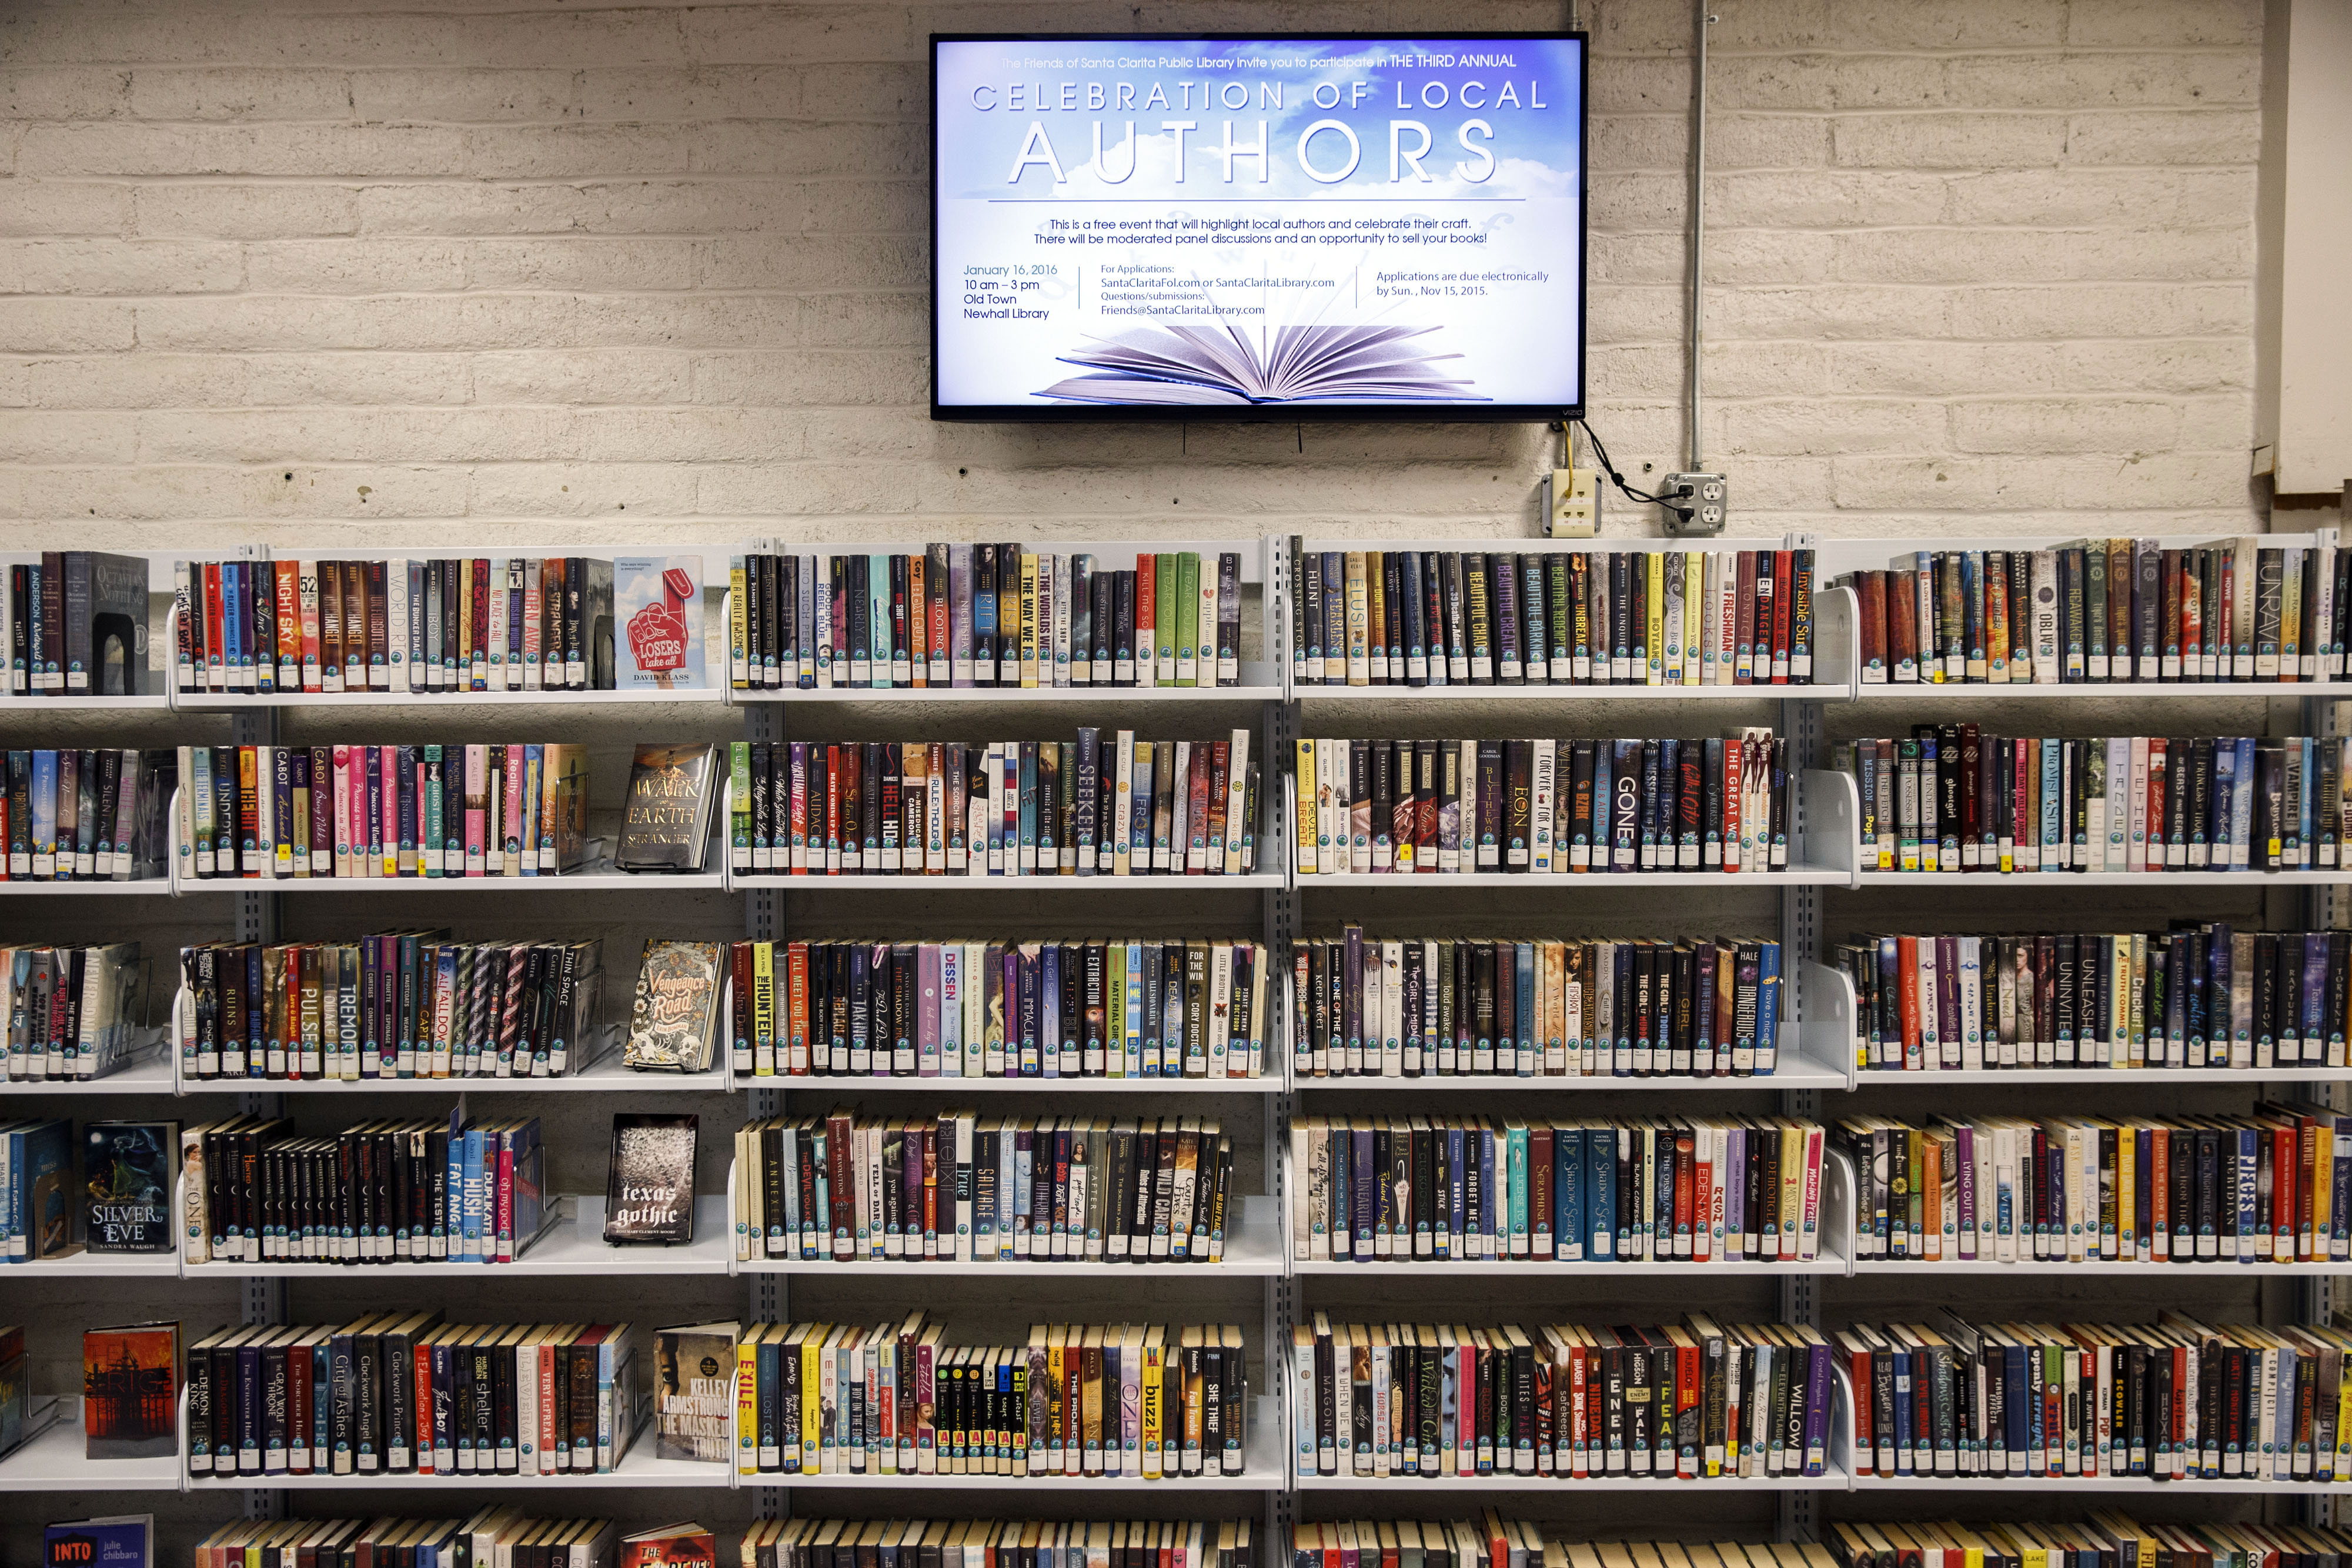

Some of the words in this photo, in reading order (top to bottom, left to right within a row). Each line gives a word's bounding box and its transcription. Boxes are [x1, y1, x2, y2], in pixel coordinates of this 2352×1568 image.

[1002, 58, 1020, 68] The
[1024, 58, 1063, 68] Friends
[1067, 58, 1079, 68] of
[1081, 58, 1114, 68] Santa
[1118, 58, 1155, 68] Clarita
[1159, 58, 1193, 68] Public
[1197, 58, 1234, 70] Library
[1271, 57, 1291, 69] you
[1295, 57, 1307, 68] to
[1310, 56, 1374, 69] participate
[1377, 56, 1387, 67] in
[1390, 55, 1412, 67] THE
[1416, 55, 1454, 67] THIRD
[1458, 55, 1516, 67] ANNUAL
[971, 81, 1283, 111] CELEBRATION
[1313, 81, 1367, 109] OF
[1396, 81, 1547, 109] LOCAL
[1007, 121, 1496, 183] AUTHORS
[1051, 219, 1070, 229] This
[1073, 219, 1079, 229] is
[1094, 219, 1115, 229] free
[1120, 220, 1152, 229] event
[1155, 219, 1178, 229] that
[1182, 219, 1198, 229] will
[1201, 219, 1249, 232] highlight
[1252, 219, 1280, 229] local
[1284, 219, 1325, 229] authors
[1328, 219, 1351, 229] and
[1355, 219, 1410, 229] celebrate
[1414, 219, 1438, 229] their
[1442, 219, 1471, 229] craft.
[1035, 234, 1065, 244] There
[1068, 234, 1085, 244] will
[1088, 234, 1104, 244] be
[1107, 234, 1172, 244] moderated
[1176, 234, 1208, 246] panel
[1211, 233, 1271, 244] discussions
[1275, 233, 1298, 243] and
[1319, 233, 1384, 245] opportunity
[1388, 233, 1399, 243] to
[1402, 233, 1419, 243] sell
[1423, 235, 1446, 245] your
[1451, 233, 1487, 243] books!
[964, 265, 1009, 276] January
[1013, 265, 1029, 276] 16,
[1031, 265, 1057, 275] 2016
[1101, 265, 1115, 273] For
[1118, 265, 1174, 275] Applications:
[1377, 272, 1439, 282] Applications
[1460, 271, 1479, 281] due
[1482, 271, 1548, 282] electronically
[965, 280, 976, 290] 10
[1011, 280, 1017, 290] 3
[1021, 282, 1039, 292] pm
[1216, 278, 1334, 289] SantaClaritaLibrary.com
[1377, 286, 1388, 296] by
[1391, 287, 1412, 295] Sun.
[1421, 287, 1440, 295] Nov
[1444, 287, 1458, 297] 15,
[1462, 287, 1488, 295] 2015.
[964, 295, 984, 305] Old
[987, 295, 1017, 305] Town
[1101, 292, 1204, 302] Questions/submissions:
[964, 309, 1008, 319] Newhall
[1013, 309, 1049, 321] Library
[1101, 305, 1264, 316] Friends@SantaClaritaLibrary.com
[279, 573, 292, 616] NIGHT
[913, 584, 924, 620] BOX
[1308, 571, 1317, 609] HUNT
[1797, 571, 1811, 621] Invisible
[980, 593, 992, 635] RIFT
[1722, 593, 1733, 651] FRESHMAN
[15, 621, 24, 646] TWISTED
[279, 619, 293, 644] SKY
[913, 623, 924, 647] OUT
[640, 640, 681, 658] LOSERS
[646, 657, 664, 667] take
[666, 656, 677, 666] all
[315, 750, 325, 784] CABOT
[1729, 748, 1738, 770] THE
[636, 777, 698, 797] WALK
[1865, 760, 1873, 801] MISSION
[1078, 765, 1094, 840] SEEKER
[1617, 776, 1636, 839] GONE
[627, 808, 695, 824] EARTH
[945, 954, 956, 1000] DESSEN
[1189, 972, 1203, 980] WIN
[1190, 962, 1202, 970] THE
[648, 968, 704, 995] Vengeance
[1087, 957, 1099, 1005] EXTRACTION
[654, 989, 691, 1019] Road
[1736, 986, 1756, 1038] DANGEROUS
[2132, 977, 2144, 1027] Cracker!
[300, 989, 318, 1041] PULSE
[623, 1184, 676, 1202] texas
[957, 1169, 971, 1196] true
[978, 1169, 994, 1218] SALVAGE
[464, 1178, 482, 1217] HUSH
[1713, 1187, 1723, 1222] RASH
[92, 1205, 163, 1225] SILVER
[617, 1205, 677, 1228] gothic
[103, 1224, 144, 1242] EVE
[360, 1356, 370, 1409] Clockwork
[739, 1360, 755, 1409] EXILE
[1208, 1384, 1218, 1405] SHE
[360, 1412, 372, 1439] Angel
[1208, 1407, 1218, 1433] THIEF
[1789, 1384, 1803, 1447] WILLOW
[55, 1542, 91, 1562] INTO
[103, 1541, 121, 1550] julie
[103, 1550, 138, 1559] chibbaro
